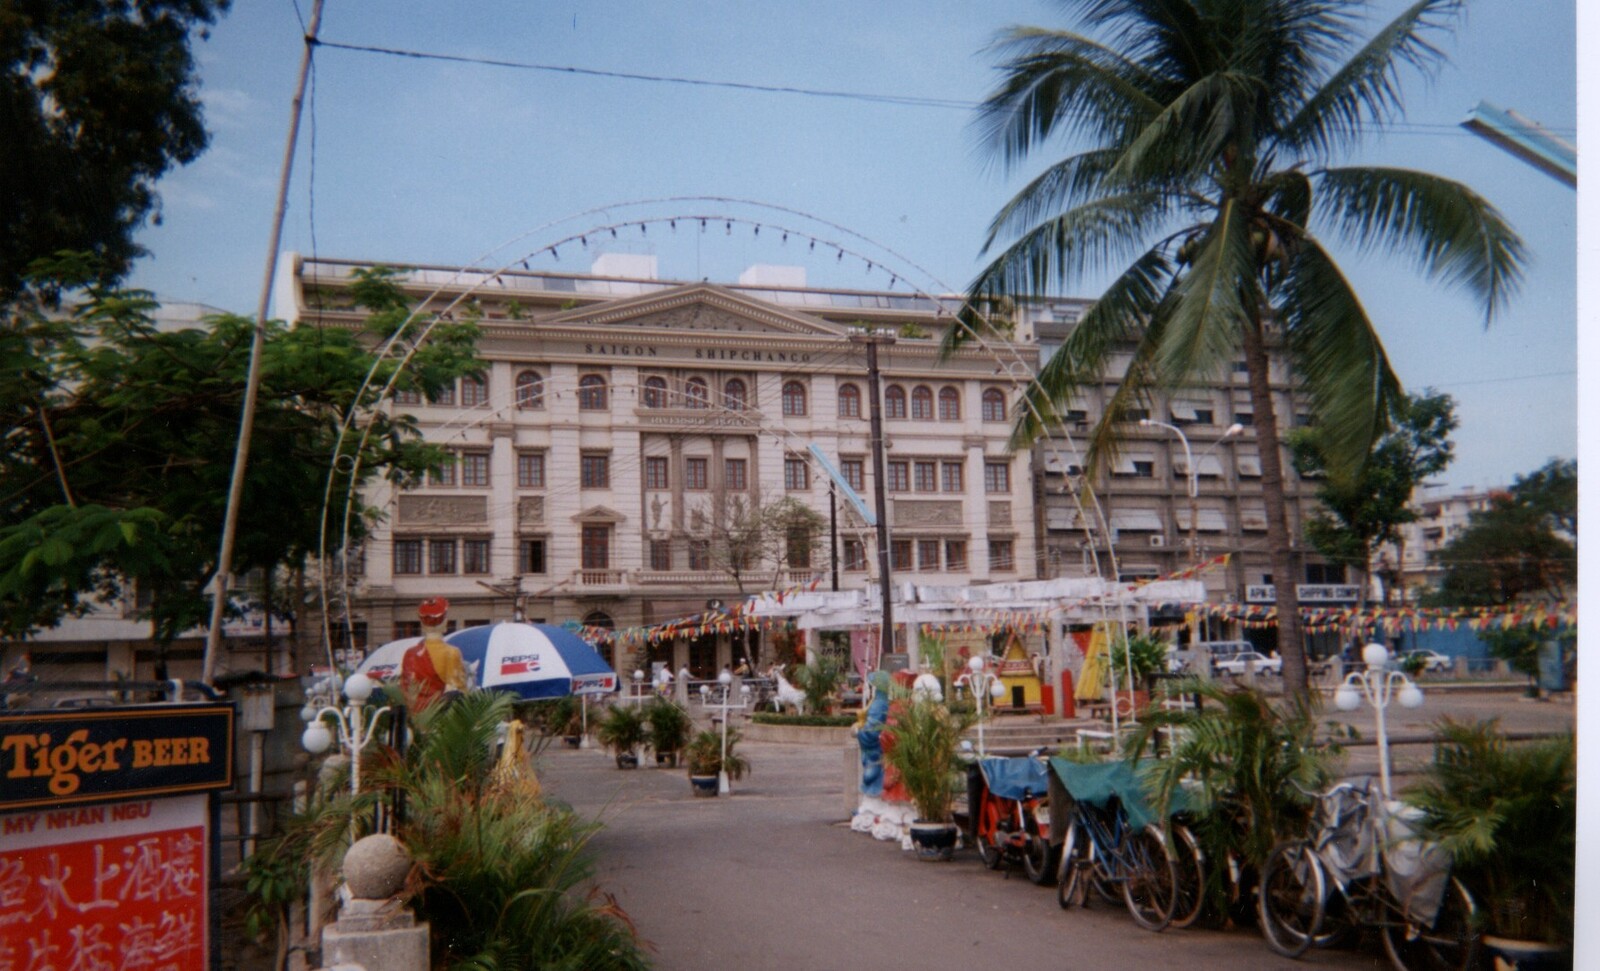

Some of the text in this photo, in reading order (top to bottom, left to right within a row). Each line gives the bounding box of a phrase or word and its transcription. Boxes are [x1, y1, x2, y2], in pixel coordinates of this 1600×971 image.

[585, 343, 811, 362] SAIGON SHIPCHANCO
[502, 653, 540, 663] PEPSI
[1, 729, 210, 795] Tiger BEER
[2, 801, 153, 836] MY NHAN NGU
